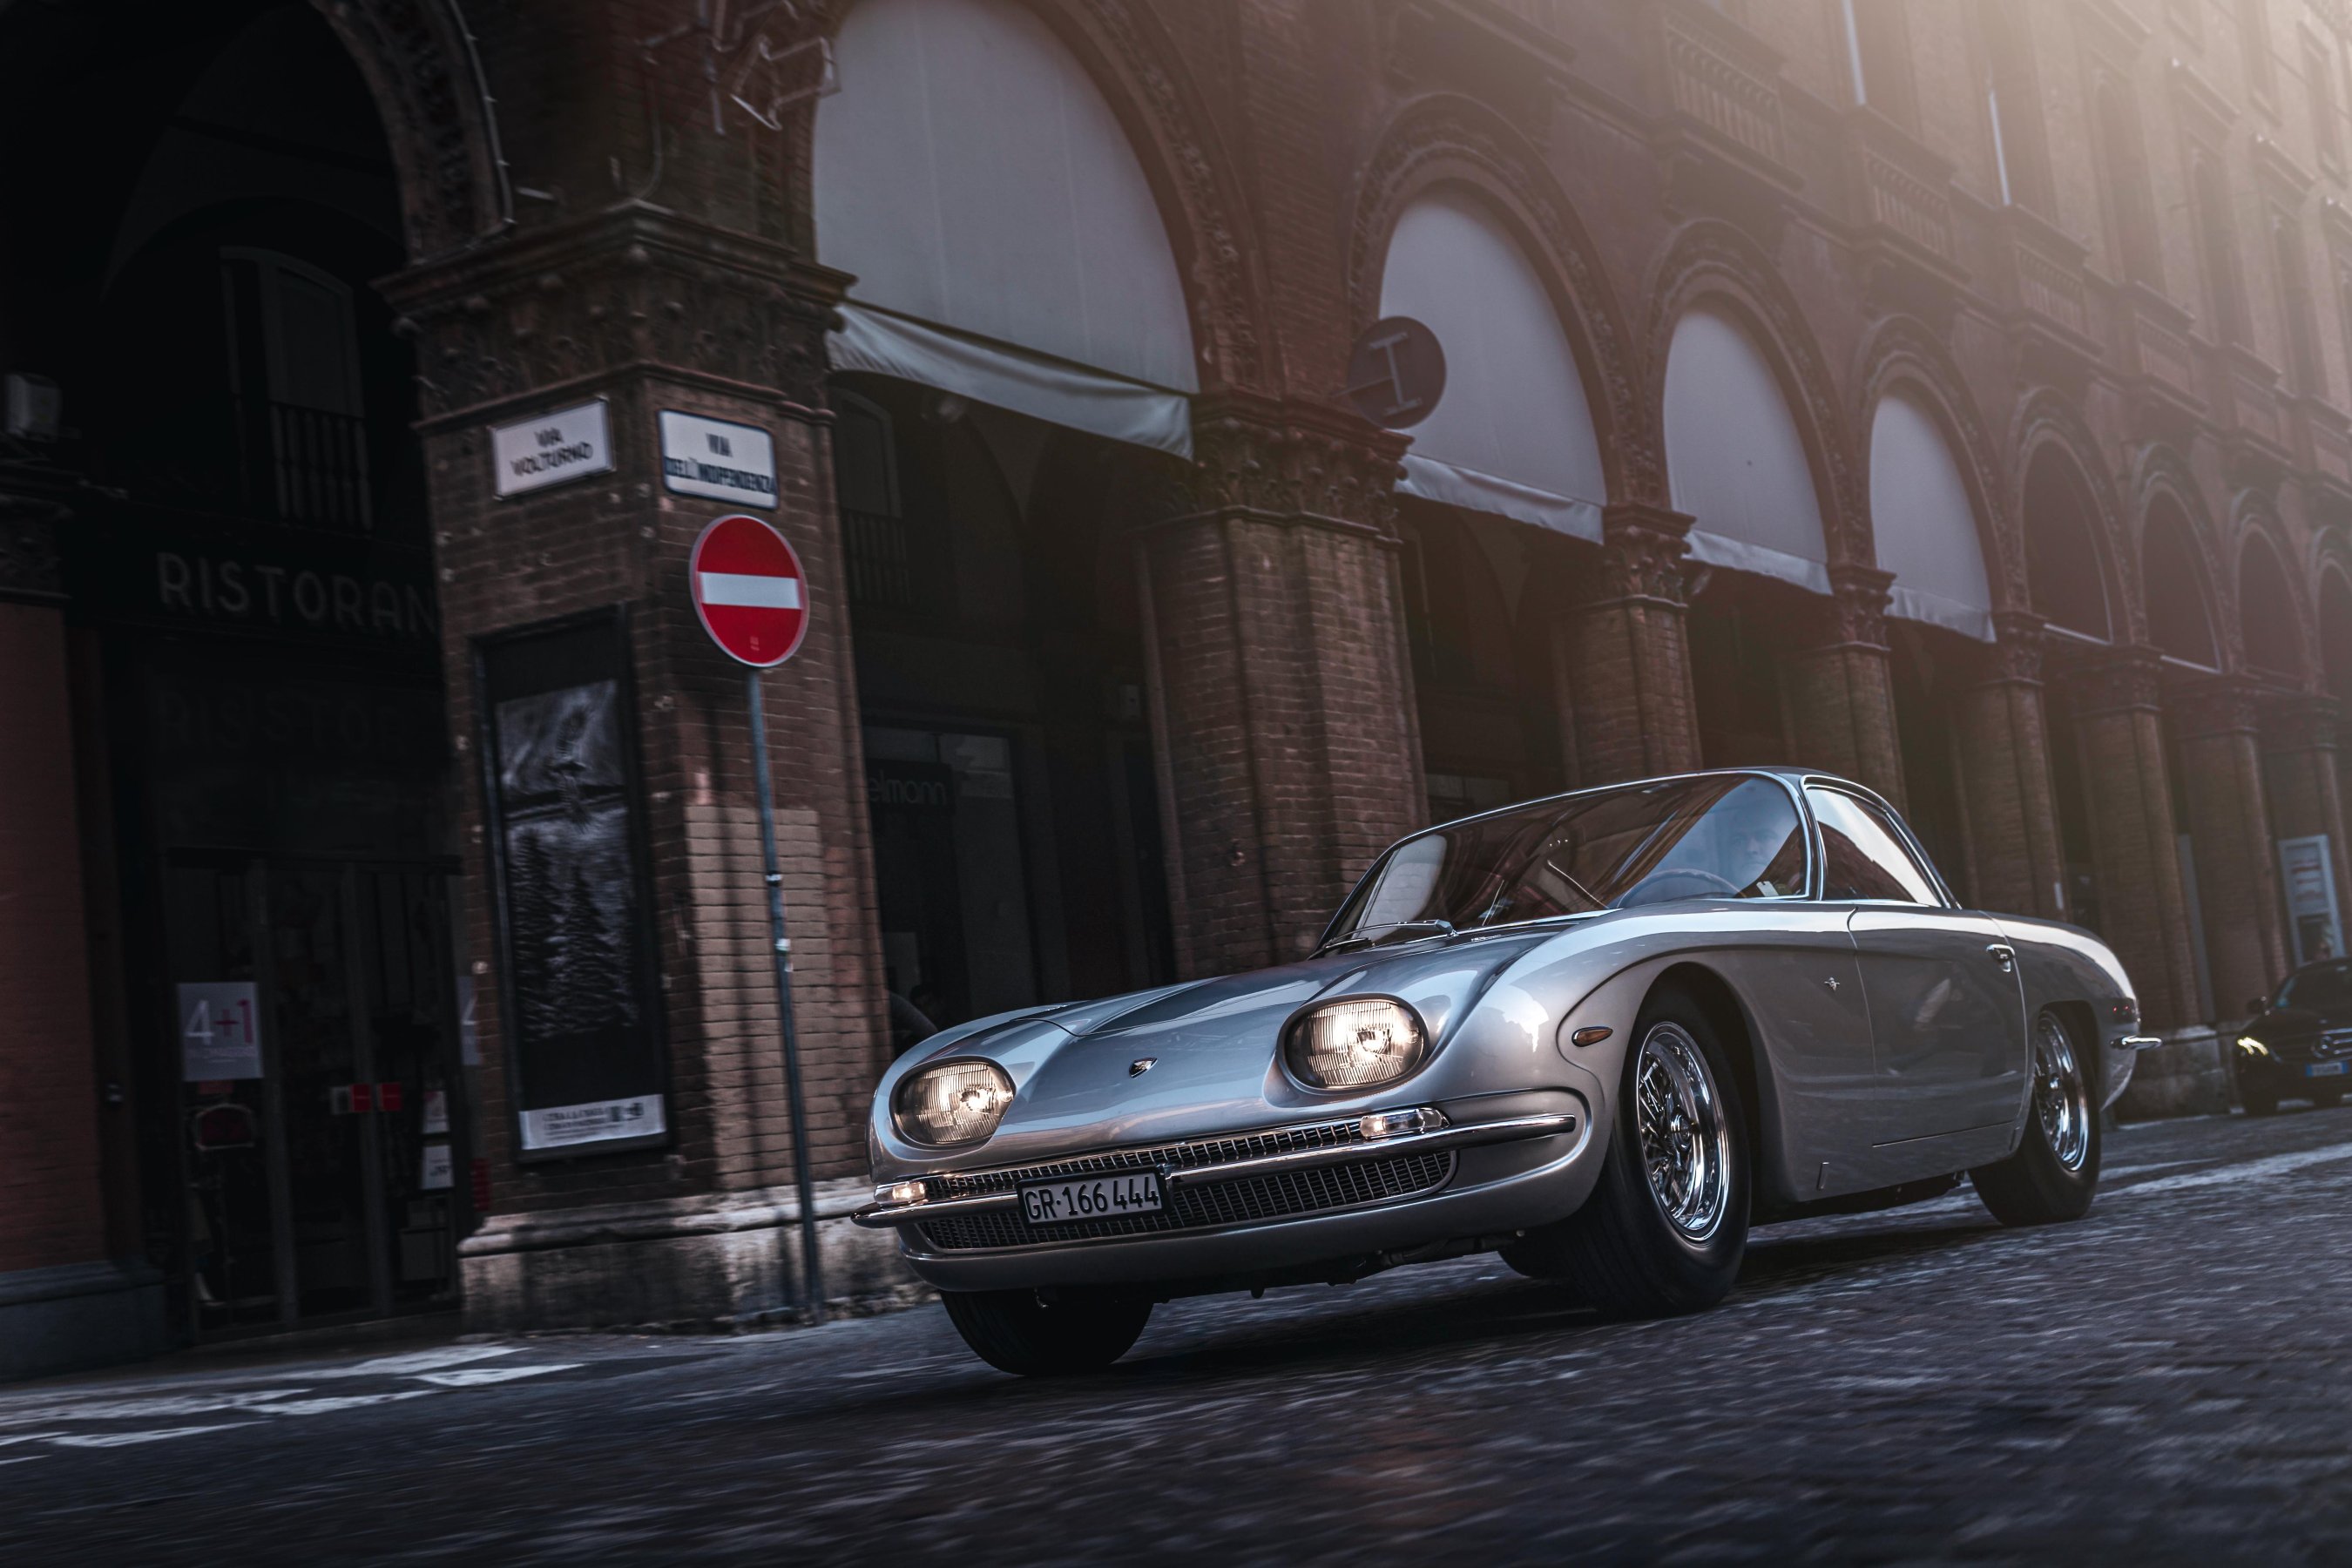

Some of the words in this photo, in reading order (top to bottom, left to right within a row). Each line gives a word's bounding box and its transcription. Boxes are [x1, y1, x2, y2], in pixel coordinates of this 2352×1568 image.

[510, 441, 594, 477] VOLTURNO
[705, 432, 733, 458] VIA
[183, 999, 253, 1045] 4+1
